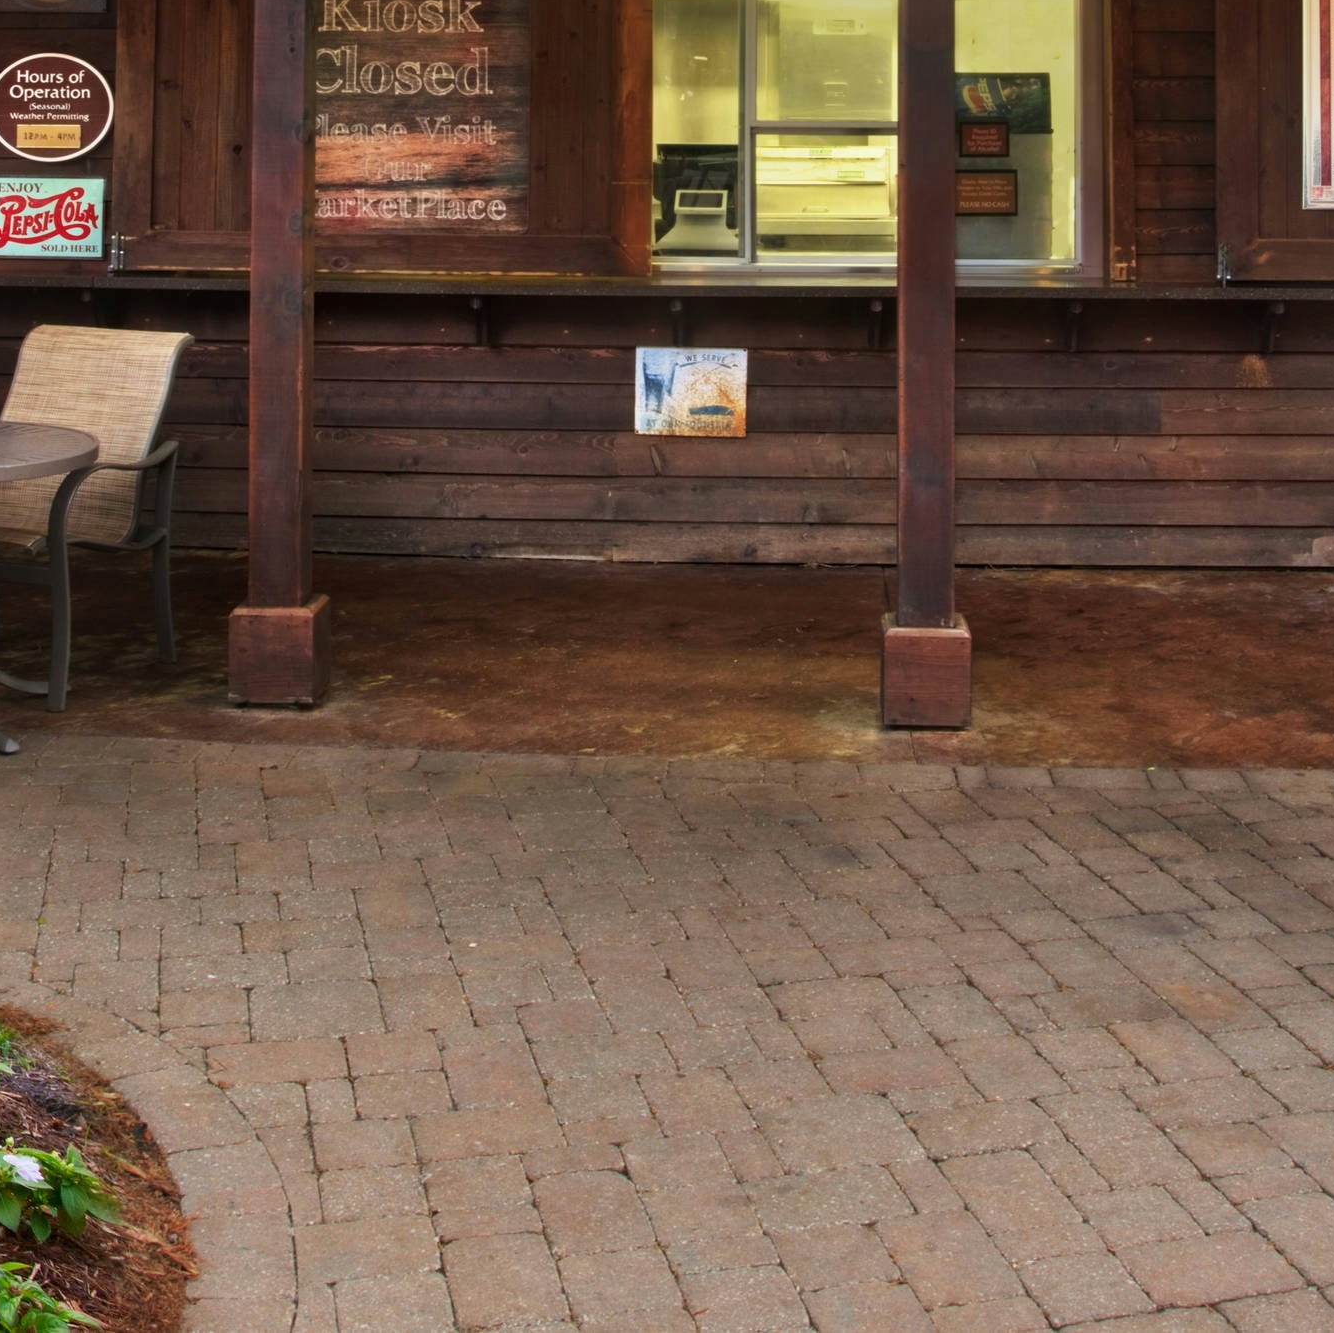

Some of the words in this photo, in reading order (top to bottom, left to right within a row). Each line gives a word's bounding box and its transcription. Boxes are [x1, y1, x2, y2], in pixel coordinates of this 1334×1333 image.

[315, 44, 494, 96] Closed
[16, 70, 64, 83] Hours
[68, 70, 85, 83] of
[9, 85, 91, 102] Operation
[29, 103, 71, 111] (Seasonal)
[10, 112, 44, 120] Weather
[47, 112, 90, 122] Permitting
[416, 115, 497, 146] Visit
[23, 132, 48, 141] 12PM
[57, 132, 76, 140] 4PM
[40, 245, 68, 253] SOLD
[70, 245, 98, 253] HERE
[685, 354, 697, 362] WE
[701, 353, 727, 363] SERVE
[646, 418, 657, 428] AT
